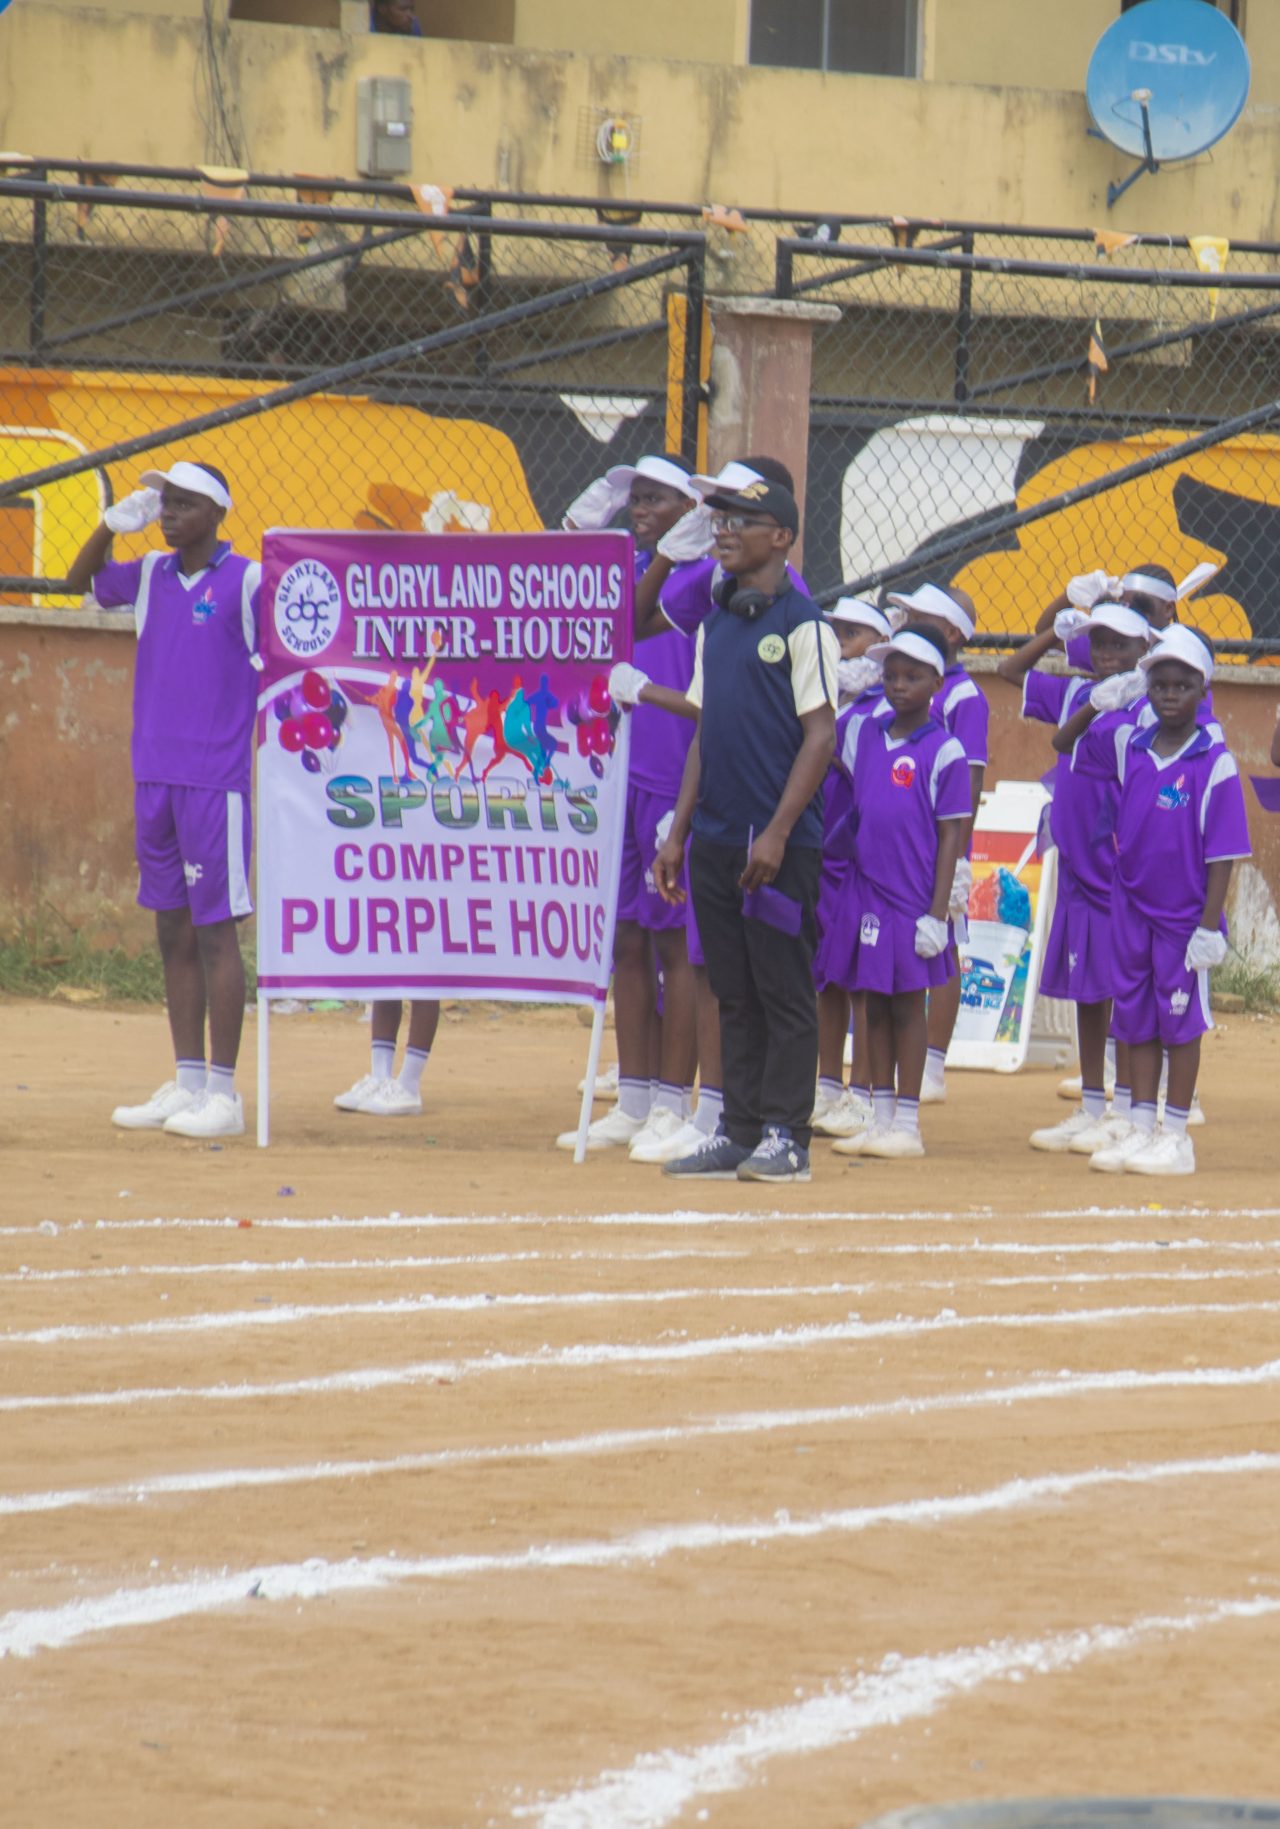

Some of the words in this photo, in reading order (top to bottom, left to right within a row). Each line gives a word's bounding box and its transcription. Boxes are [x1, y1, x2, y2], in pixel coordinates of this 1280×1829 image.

[346, 563, 502, 609] GLORYLAND
[509, 563, 622, 610] SCHOOLS
[352, 615, 614, 661] INTER-HOUSE
[326, 775, 599, 834] SPORTS
[334, 843, 599, 888] COMPETITION
[282, 897, 497, 956] PURPLE
